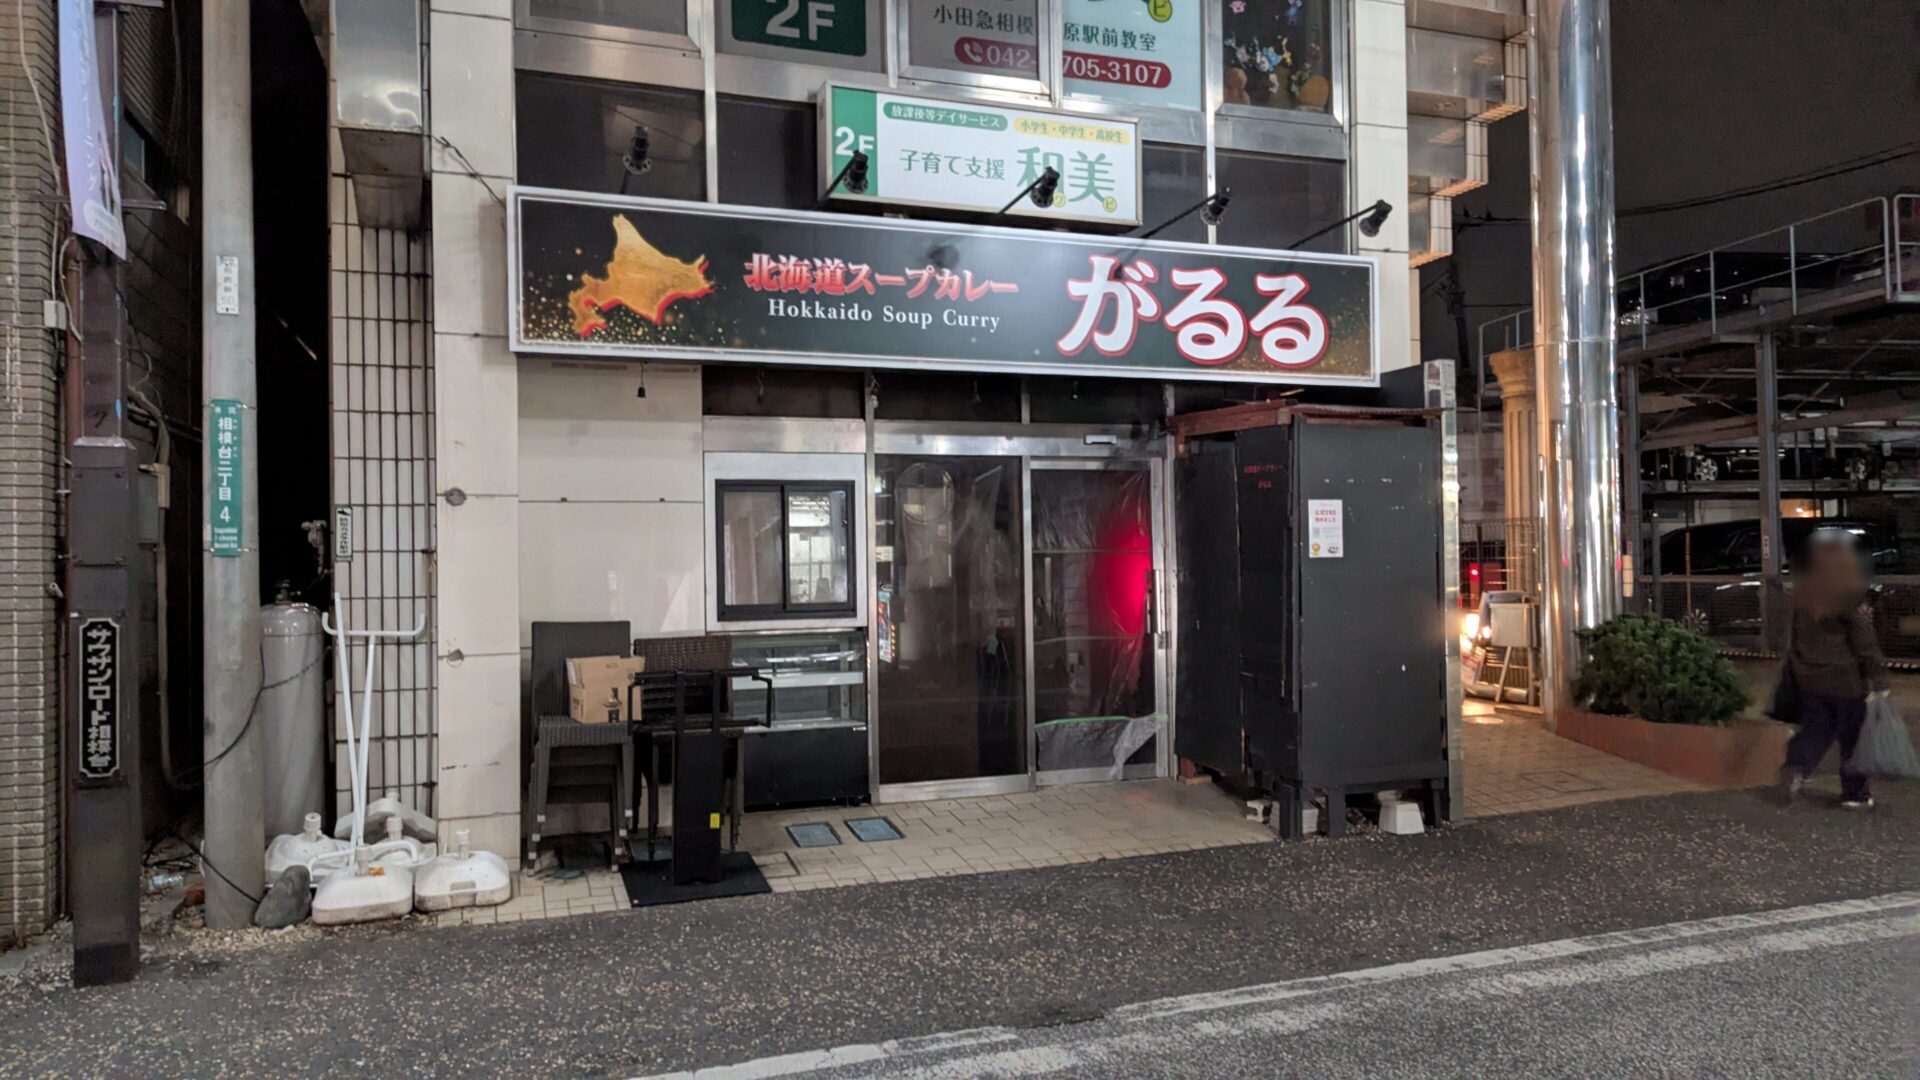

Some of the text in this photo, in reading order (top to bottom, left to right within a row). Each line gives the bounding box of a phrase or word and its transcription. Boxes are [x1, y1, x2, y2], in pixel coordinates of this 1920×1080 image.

[766, 0, 835, 41] 2F
[891, 105, 1000, 128] 放課後等デイサービス
[1021, 119, 1123, 143] 小学生・中学生・高校生
[835, 126, 875, 156] 2F
[900, 148, 1005, 180] 子育て支援
[1016, 146, 1115, 202] 和美
[743, 252, 1019, 302] 北海道スープカレー
[768, 298, 1000, 333] Hokkaido Soup Curry
[1057, 254, 1329, 367] がるる
[220, 506, 231, 522] 4
